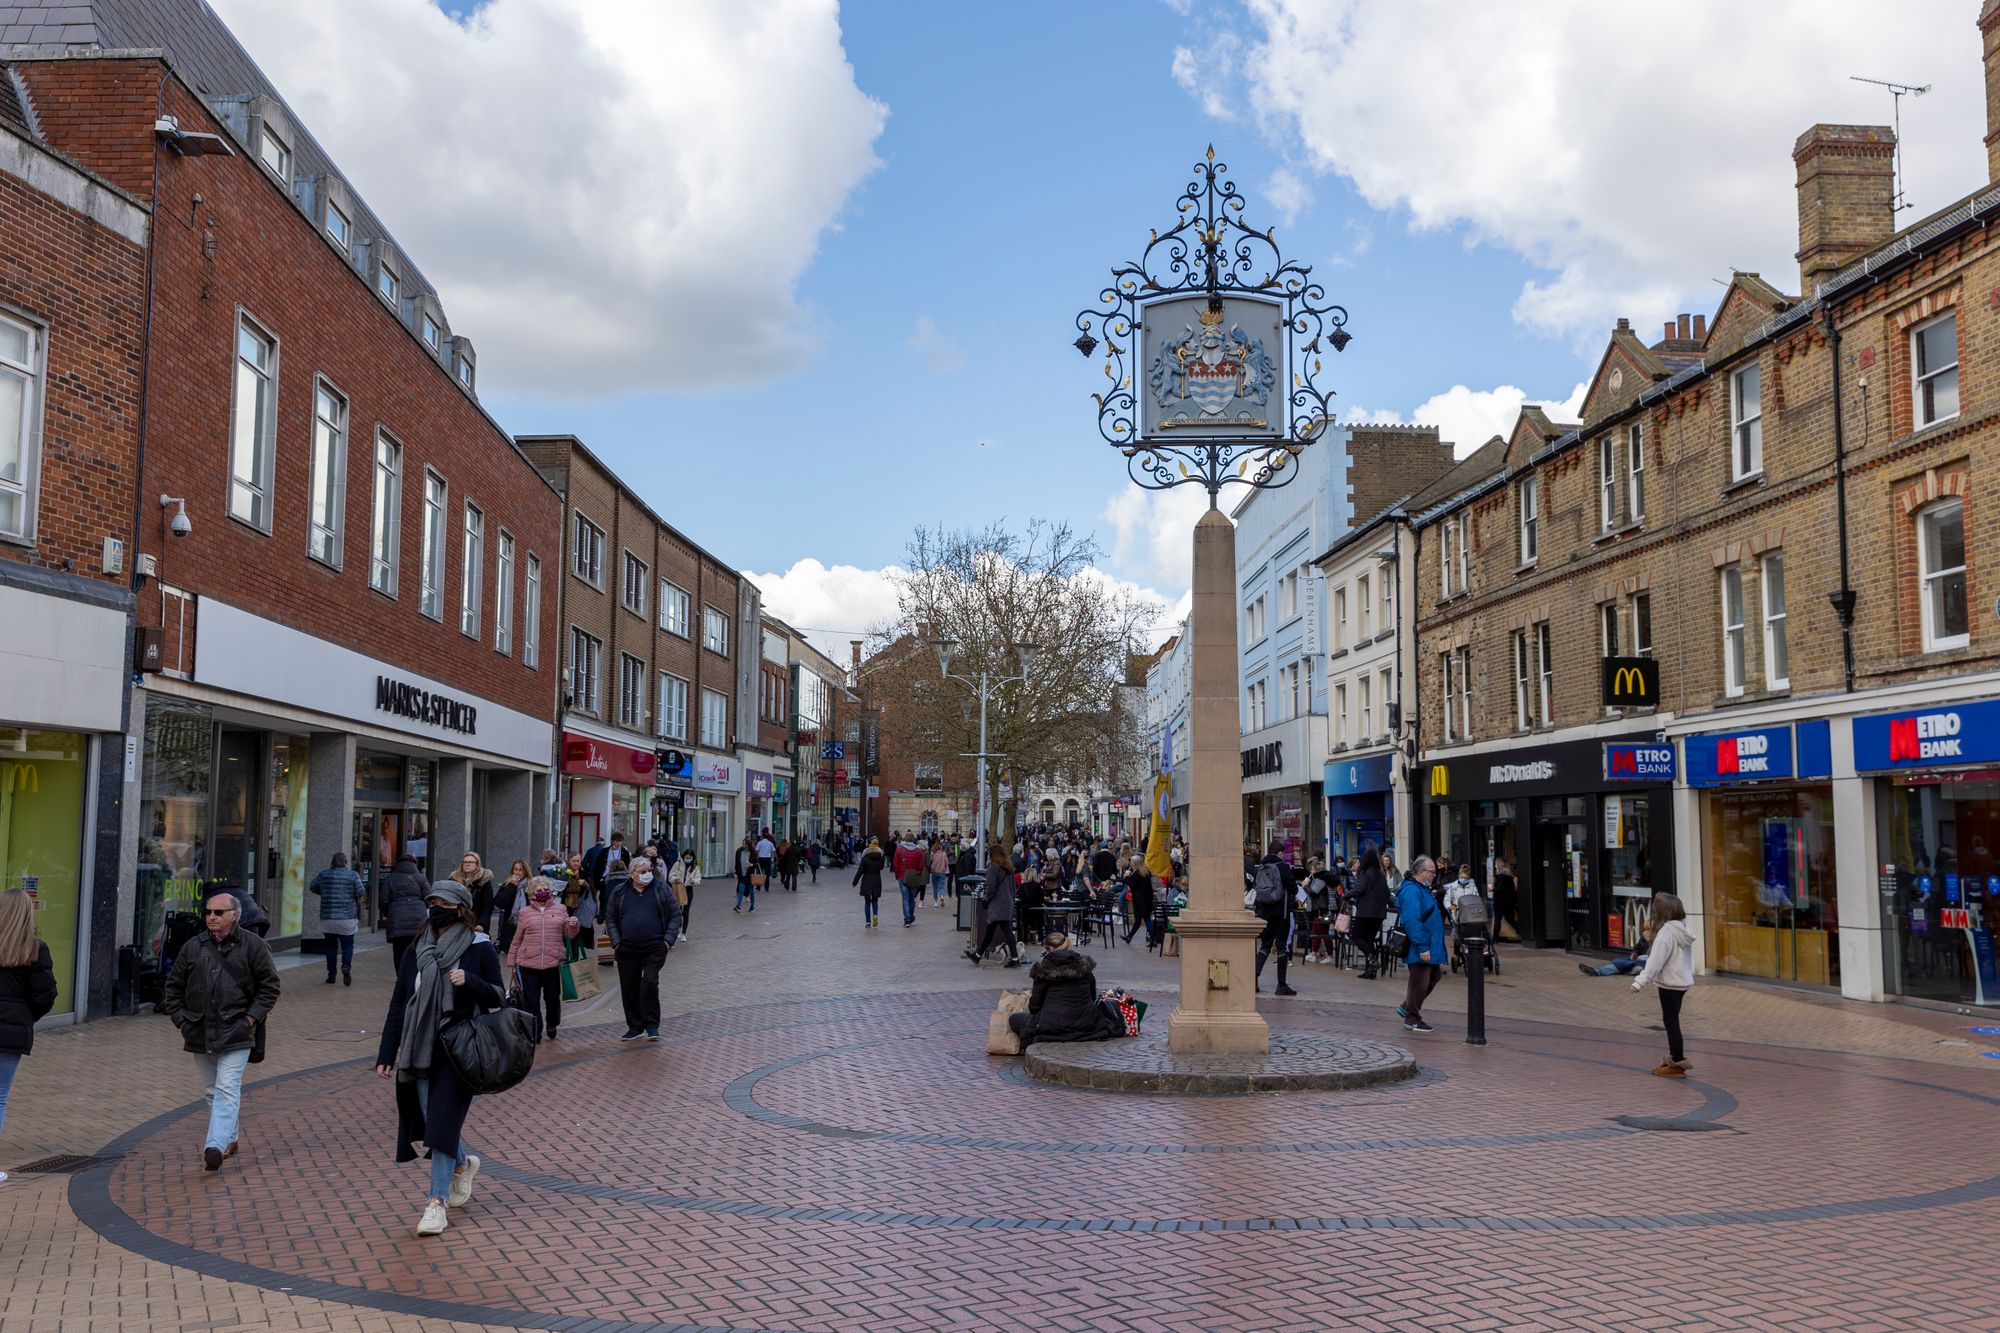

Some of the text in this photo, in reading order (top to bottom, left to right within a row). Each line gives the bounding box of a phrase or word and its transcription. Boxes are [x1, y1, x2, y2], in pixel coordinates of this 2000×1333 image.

[1306, 579, 1316, 652] DEBENHAMS
[1889, 713, 1962, 761] METRO
[1919, 739, 1963, 759] BANK
[1241, 740, 1283, 780] NHAMS
[1612, 749, 1672, 774] METRO
[1717, 735, 1769, 774] METRO
[1738, 757, 1769, 773] BANK
[1489, 761, 1553, 783] McDonald's
[1638, 763, 1672, 774] BANK
